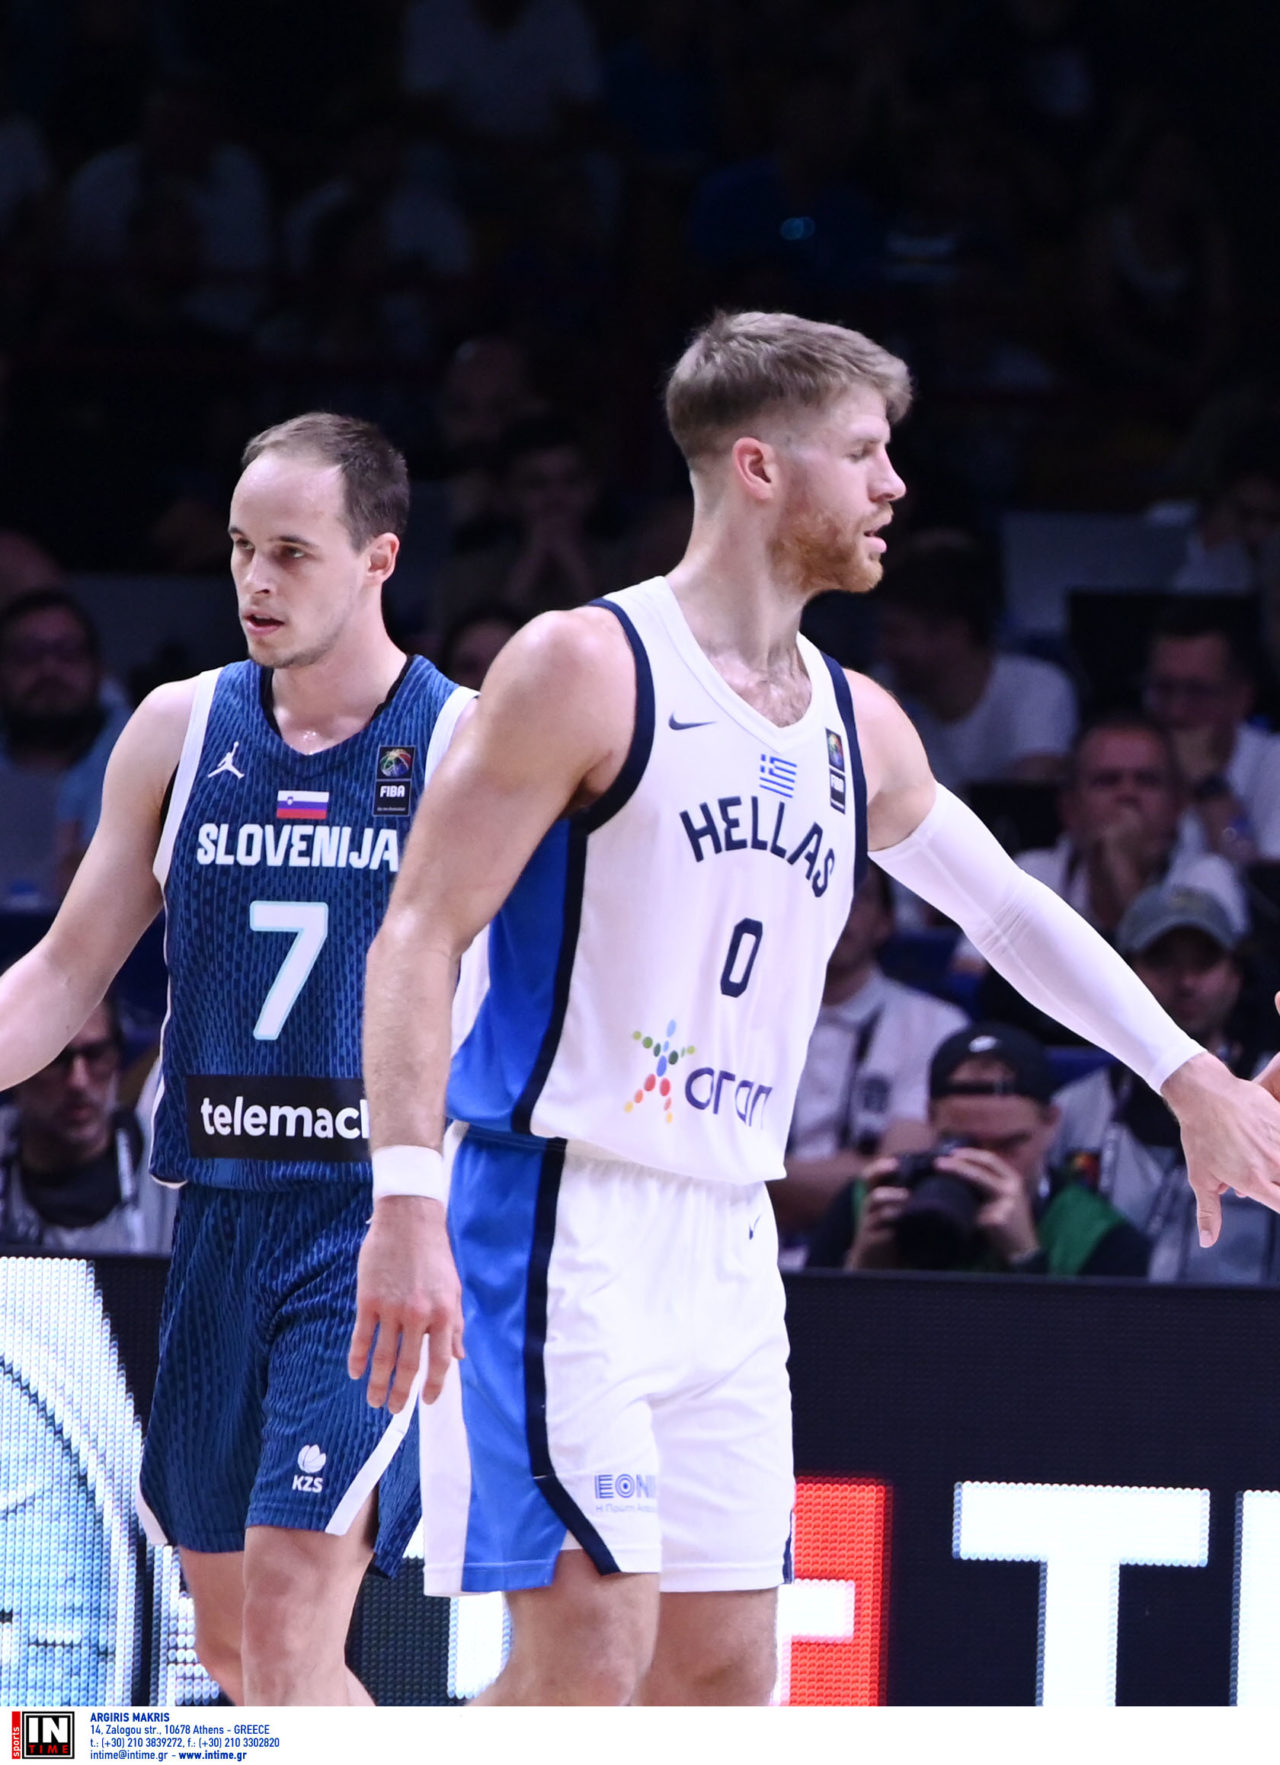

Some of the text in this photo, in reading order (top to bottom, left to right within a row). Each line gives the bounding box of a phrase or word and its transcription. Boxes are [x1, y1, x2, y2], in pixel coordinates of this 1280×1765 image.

[380, 785, 405, 798] FIBA
[196, 823, 400, 871] SLOVENIJA
[679, 796, 835, 898] HELLAS
[250, 900, 329, 1041] 7
[720, 917, 763, 998] 0
[292, 1474, 324, 1493] KZS
